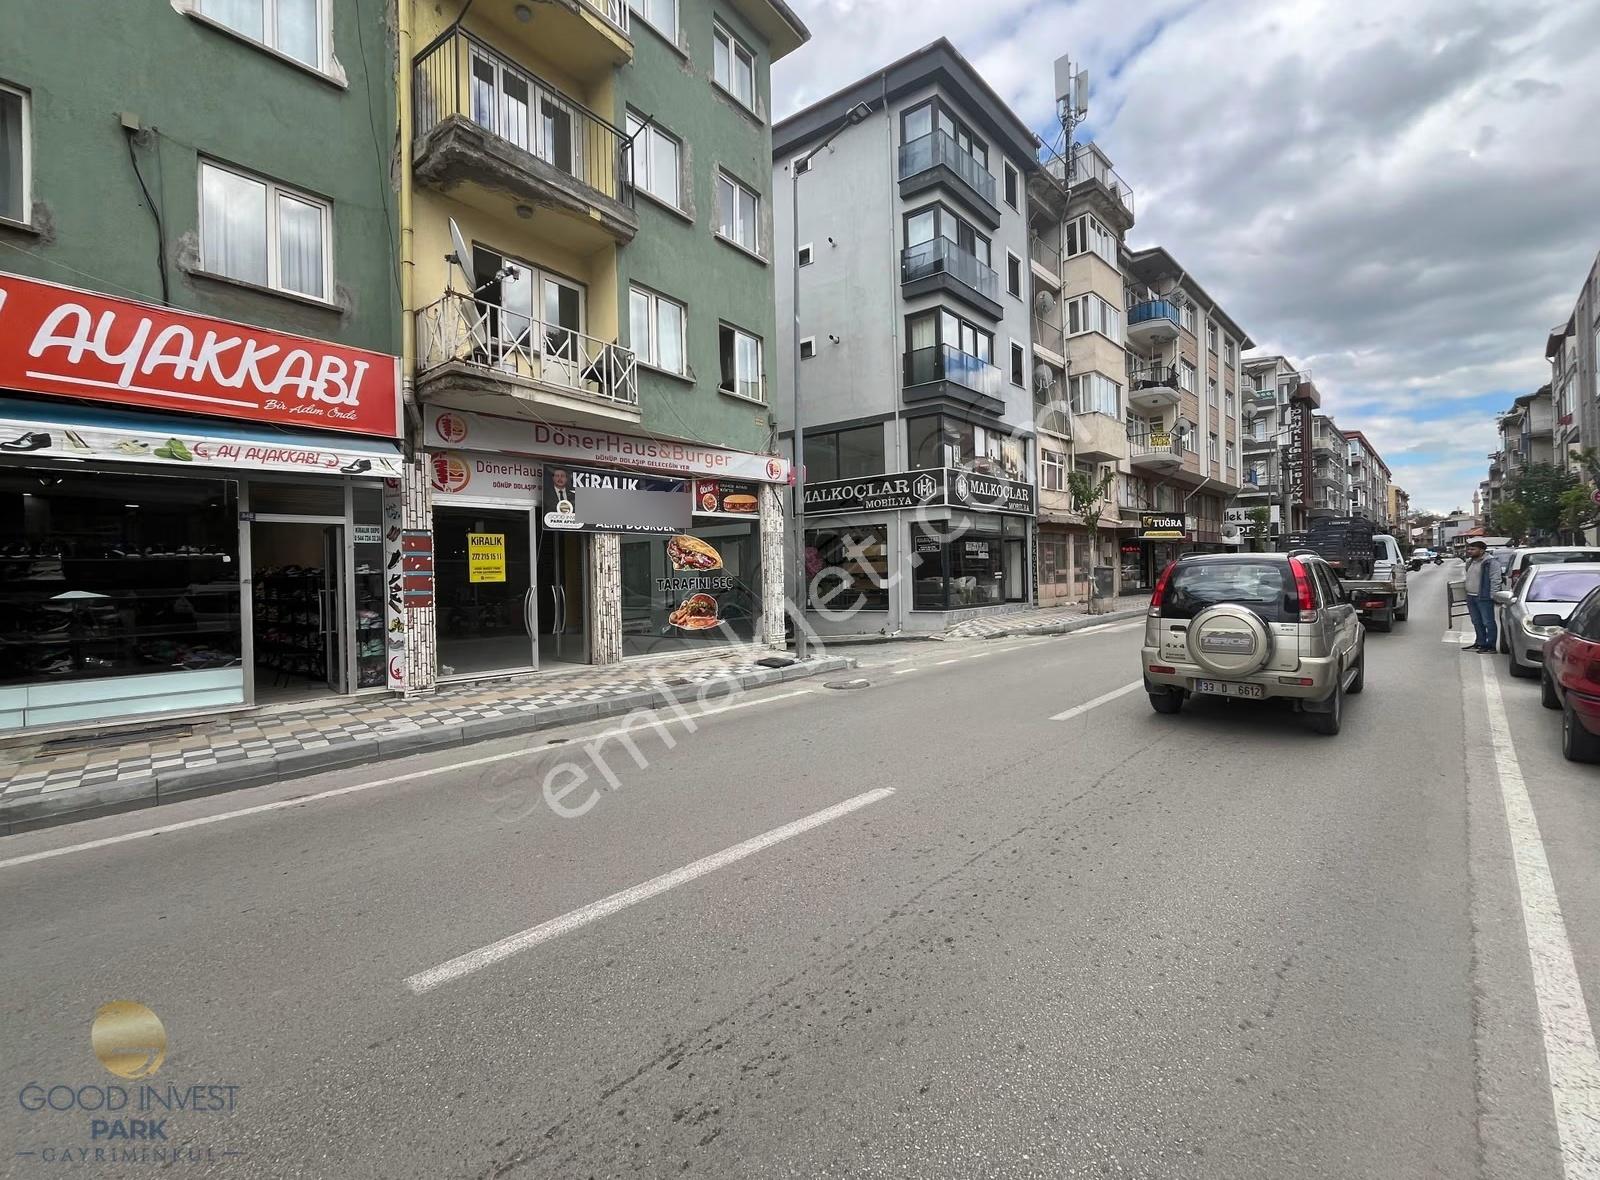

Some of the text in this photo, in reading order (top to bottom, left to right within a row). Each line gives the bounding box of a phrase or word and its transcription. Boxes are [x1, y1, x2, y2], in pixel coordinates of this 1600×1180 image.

[28, 303, 370, 406] AYAKKABI
[264, 400, 288, 411] Bir
[216, 445, 321, 465] AY AYAKKABI
[535, 424, 732, 468] DönerHaus&Burger
[803, 479, 910, 503] MALKOÇLAR
[970, 480, 1029, 502] MALKOÇLAR
[1153, 516, 1183, 528] TUĞRA
[1203, 682, 1261, 696] 33 D 6612
